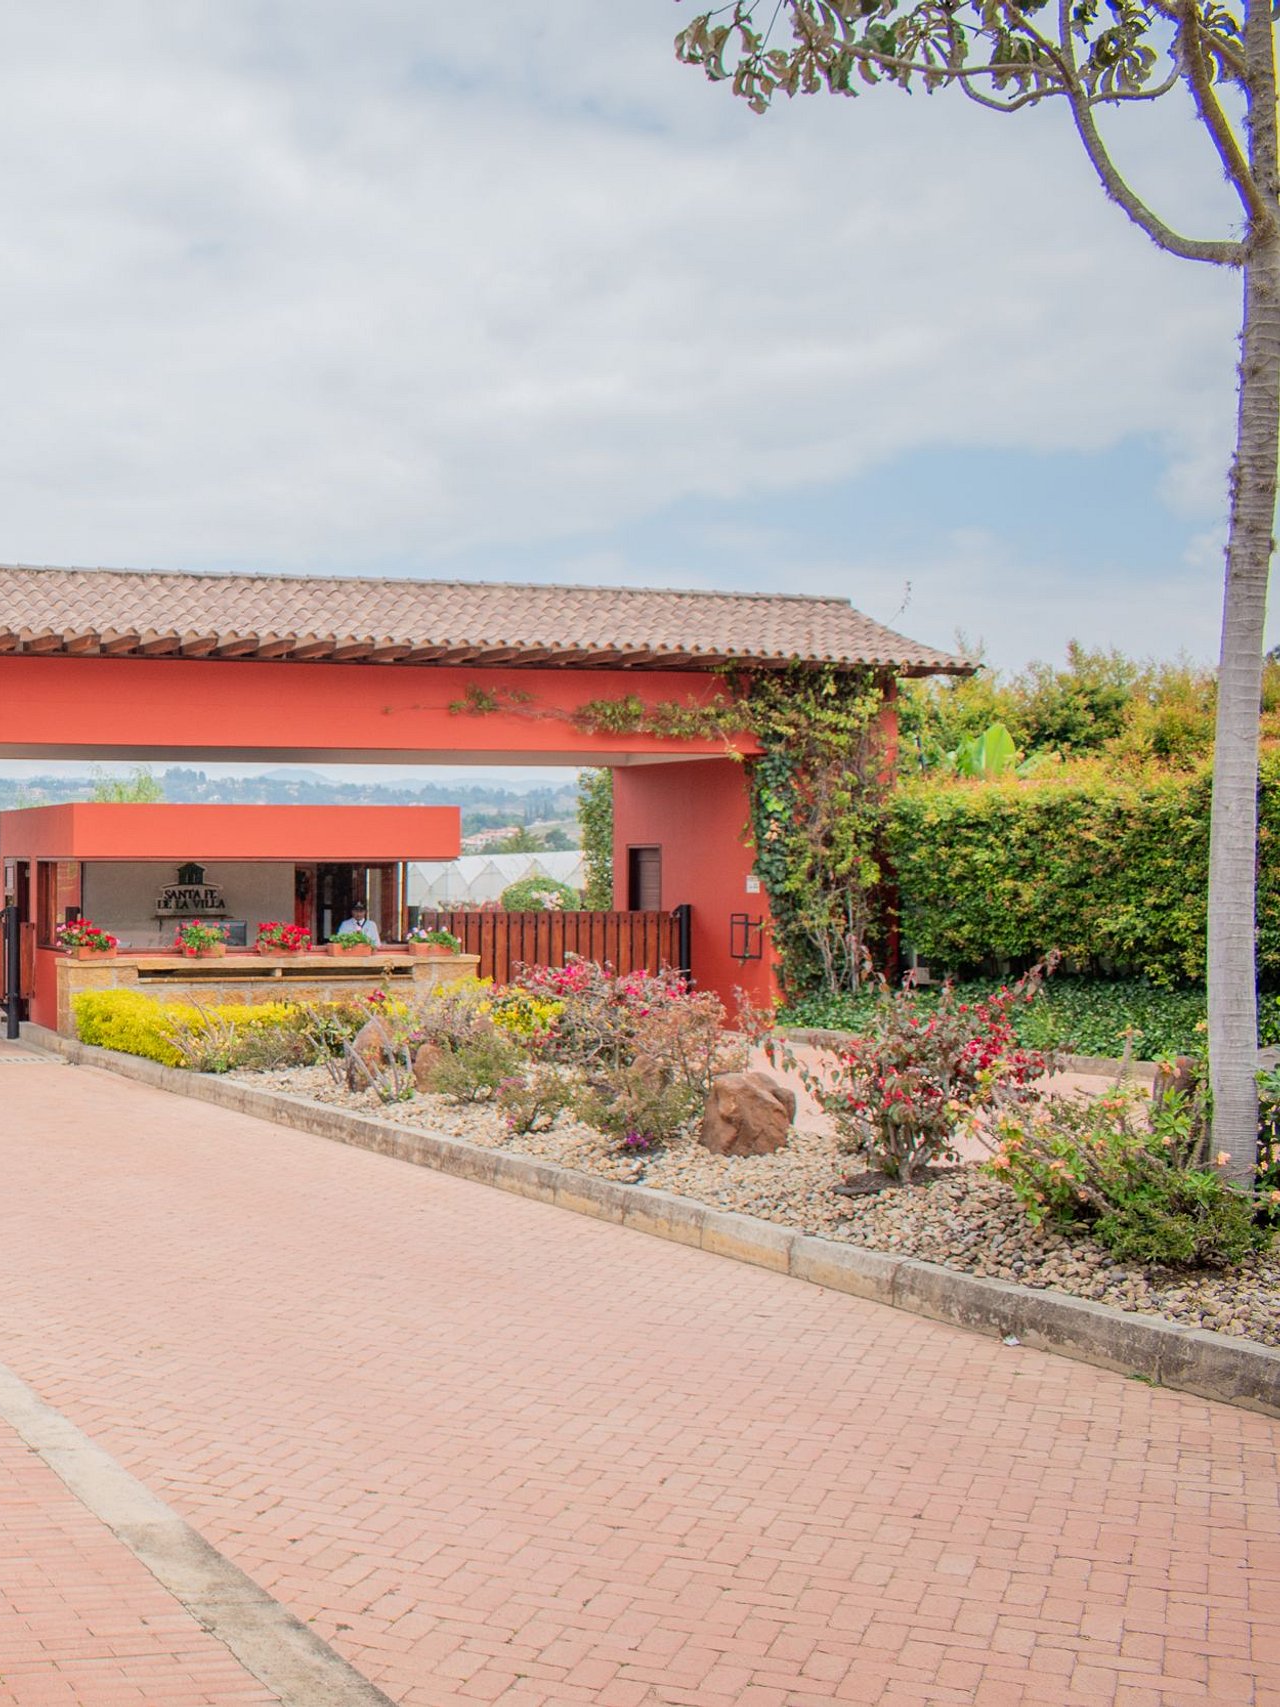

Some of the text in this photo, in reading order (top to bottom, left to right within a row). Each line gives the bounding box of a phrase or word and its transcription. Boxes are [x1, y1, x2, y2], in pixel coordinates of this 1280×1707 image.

[164, 889, 217, 899] SANTA FE
[157, 899, 225, 909] DE LA VILLA
